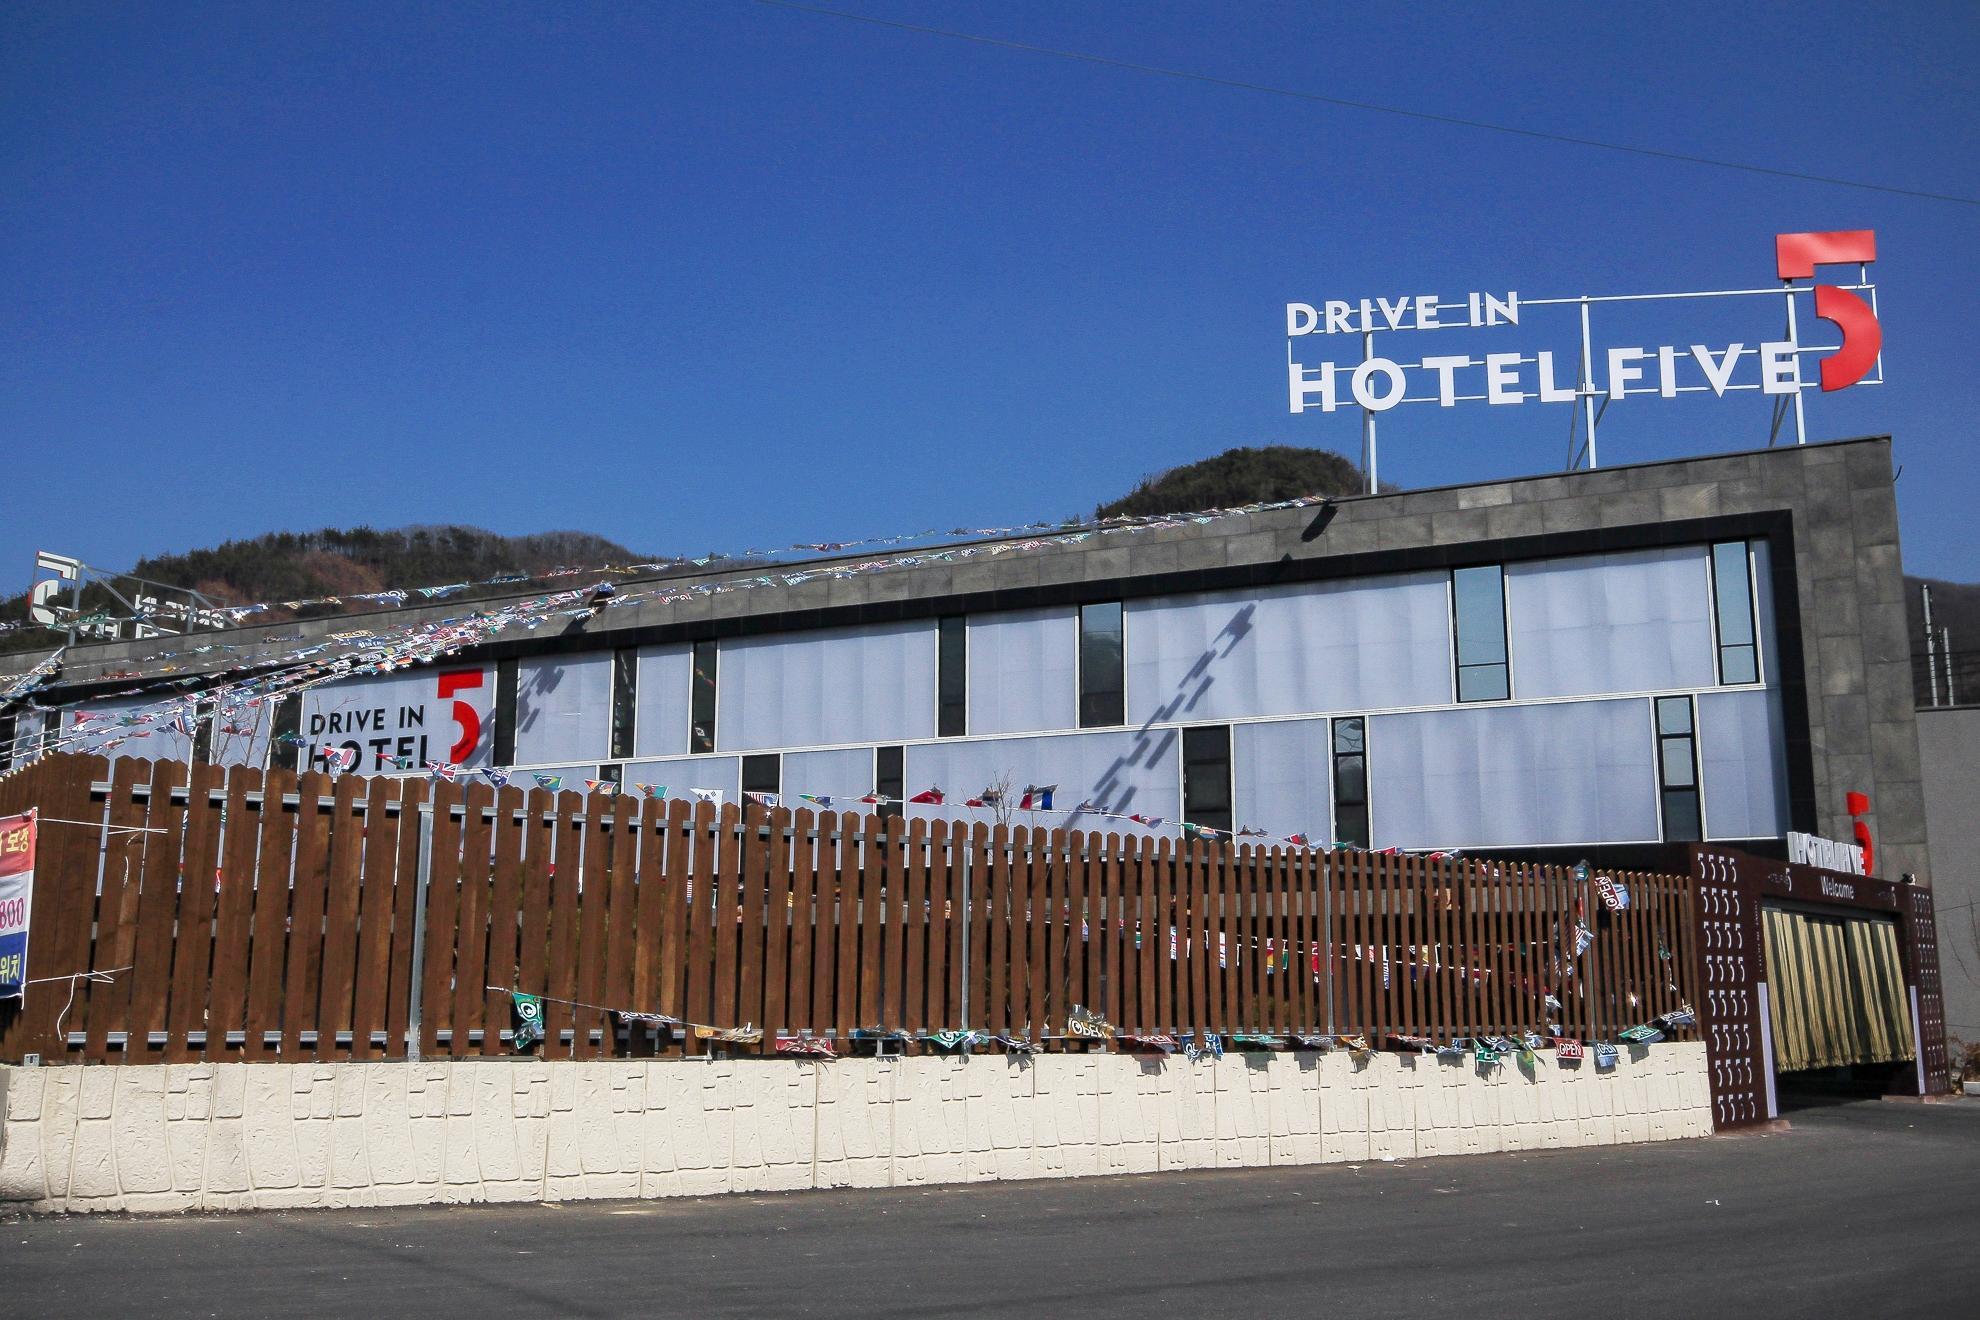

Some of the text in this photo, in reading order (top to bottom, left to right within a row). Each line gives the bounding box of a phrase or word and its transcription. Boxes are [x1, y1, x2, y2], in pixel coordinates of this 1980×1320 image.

[1286, 291, 1519, 336] DRIVE IN
[1776, 229, 1883, 392] 5
[1288, 341, 1801, 414] HOTEL FIVE
[310, 704, 425, 736] DRIVE IN
[437, 668, 484, 765] 5
[1595, 876, 1618, 908] OPEN
[1821, 875, 1855, 900] Welcome
[1559, 1043, 1583, 1056] OPEN
